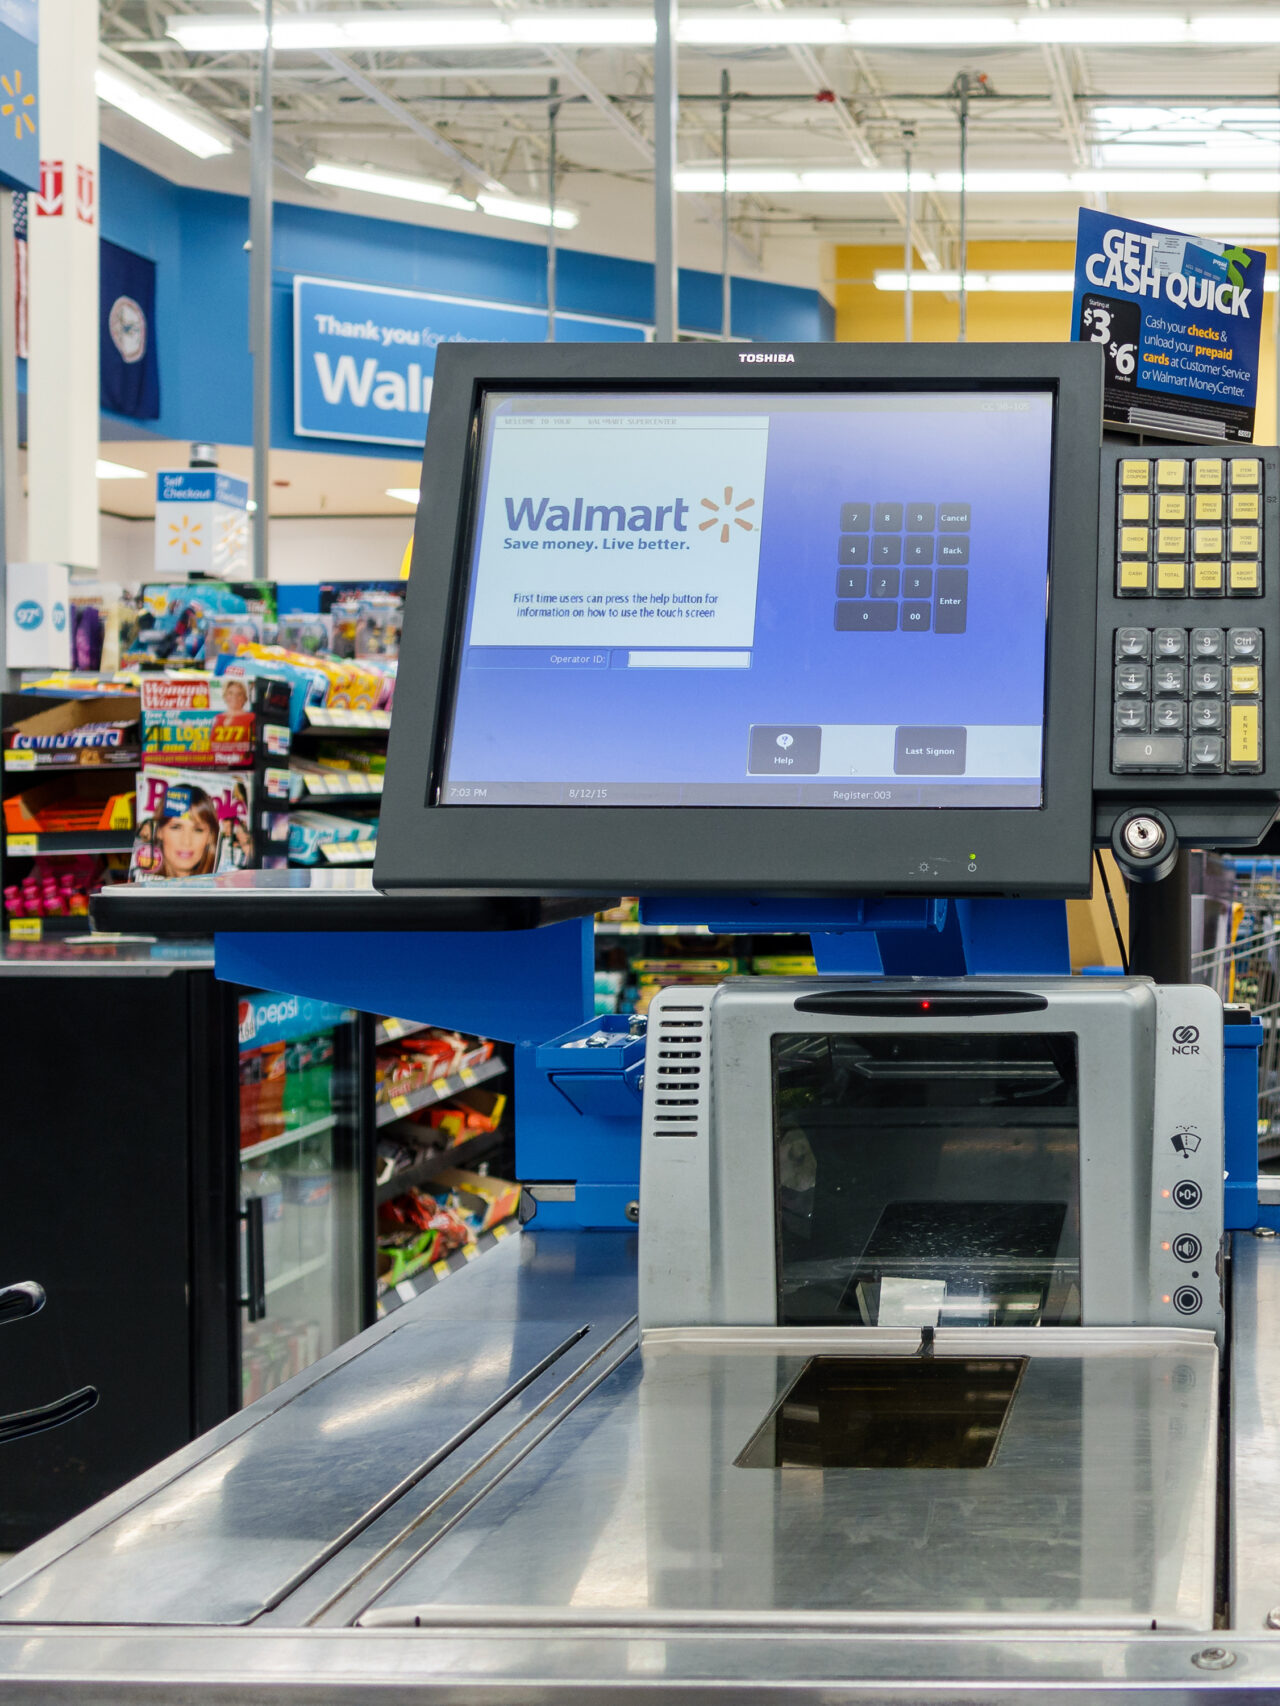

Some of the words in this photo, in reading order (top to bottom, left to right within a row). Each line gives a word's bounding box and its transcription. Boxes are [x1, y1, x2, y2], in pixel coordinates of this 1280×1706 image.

[1103, 229, 1158, 269] GET
[1085, 253, 1161, 299] CASH
[1165, 273, 1252, 318] QUICK
[1089, 298, 1105, 309] Starting
[314, 314, 379, 341] Thank
[381, 327, 420, 346] you
[1145, 315, 1166, 330] Cash
[1167, 321, 1186, 334] your
[1187, 324, 1219, 341] checks
[1220, 330, 1227, 342] &
[1144, 335, 1174, 350] unload
[1174, 341, 1194, 354] your
[1195, 344, 1232, 360] prepaid
[738, 353, 795, 363] TOSHIBA
[1143, 351, 1169, 366] cards
[1170, 357, 1179, 367] at
[1180, 357, 1221, 375] Customer
[1221, 364, 1251, 381] Service
[1142, 371, 1151, 380] or
[1152, 370, 1188, 388] Walmart
[1188, 376, 1246, 398] MoneyCenter.
[163, 487, 211, 499] Checkout
[504, 497, 689, 532] Walmart
[852, 514, 858, 522] 7
[885, 514, 890, 522] 8
[917, 514, 922, 522] 9
[941, 514, 967, 522] Cancel
[503, 538, 539, 550] Save
[542, 540, 598, 552] money.
[602, 538, 634, 550] Live
[638, 538, 690, 550] better.
[513, 593, 534, 604] First
[536, 593, 557, 604] time
[559, 595, 584, 604] users
[586, 595, 603, 604] can
[605, 595, 629, 606] press
[632, 594, 648, 604] the
[649, 594, 669, 606] help
[672, 594, 702, 604] button
[704, 594, 718, 604] for
[517, 606, 570, 617] information
[572, 609, 584, 617] on
[587, 607, 606, 617] how
[608, 608, 619, 617] to
[621, 609, 638, 617] use
[640, 607, 654, 617] the
[657, 607, 683, 617] touch
[685, 608, 715, 617] screen
[1129, 637, 1136, 647] 7
[1167, 637, 1174, 647] 8
[1204, 637, 1211, 647] 9
[1235, 637, 1252, 646] Ctrl
[550, 655, 590, 665] Operator
[593, 655, 606, 663] ID:
[1128, 673, 1135, 683] 4
[1166, 673, 1173, 682] 5
[1204, 673, 1211, 683] 6
[1129, 710, 1134, 719] 1
[1165, 710, 1173, 720] 2
[1203, 709, 1211, 719] 3
[214, 727, 245, 742] 277
[905, 747, 924, 755] Last
[926, 747, 955, 757] Signon
[1145, 745, 1152, 755] 0
[1204, 744, 1209, 755] /
[774, 757, 794, 766] Help
[450, 788, 471, 797] 7:03
[474, 789, 487, 797] PM
[569, 789, 608, 798] 8/12/15
[833, 790, 891, 800] Register:003
[256, 994, 298, 1031] pepsi
[1172, 1045, 1200, 1055] NCR
